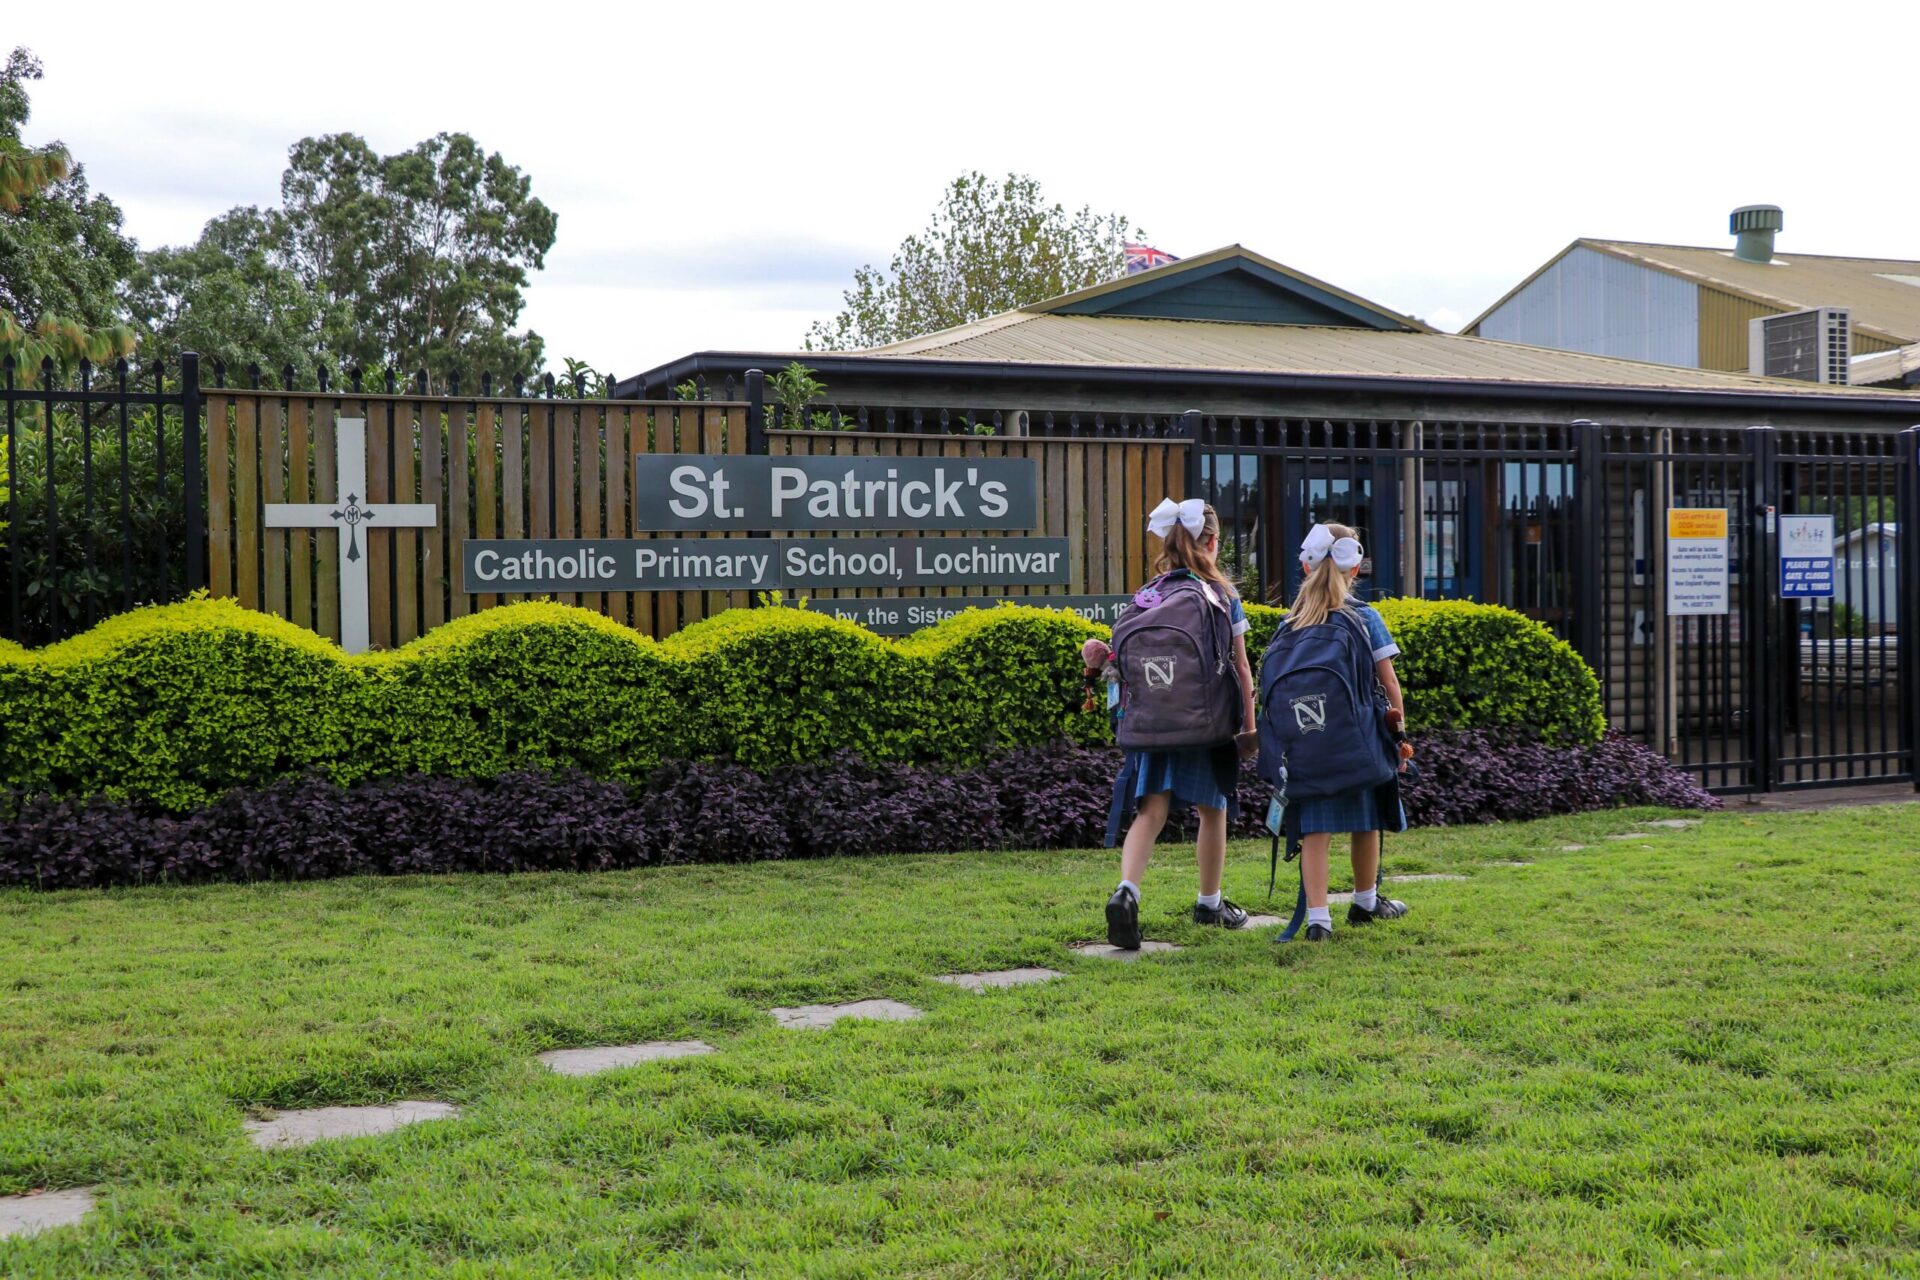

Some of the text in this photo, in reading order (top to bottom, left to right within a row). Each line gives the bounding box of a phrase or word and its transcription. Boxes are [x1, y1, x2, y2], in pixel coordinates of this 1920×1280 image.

[668, 465, 1009, 519] St. Patrick's
[474, 548, 769, 585] Catholic Primary
[786, 545, 1061, 582] School, Lochinvar
[1785, 561, 1830, 569] PLEASE KEEP
[1785, 572, 1830, 580] GATE CLOSED
[1784, 582, 1832, 591] AT ALL TIMES
[867, 607, 899, 625] the
